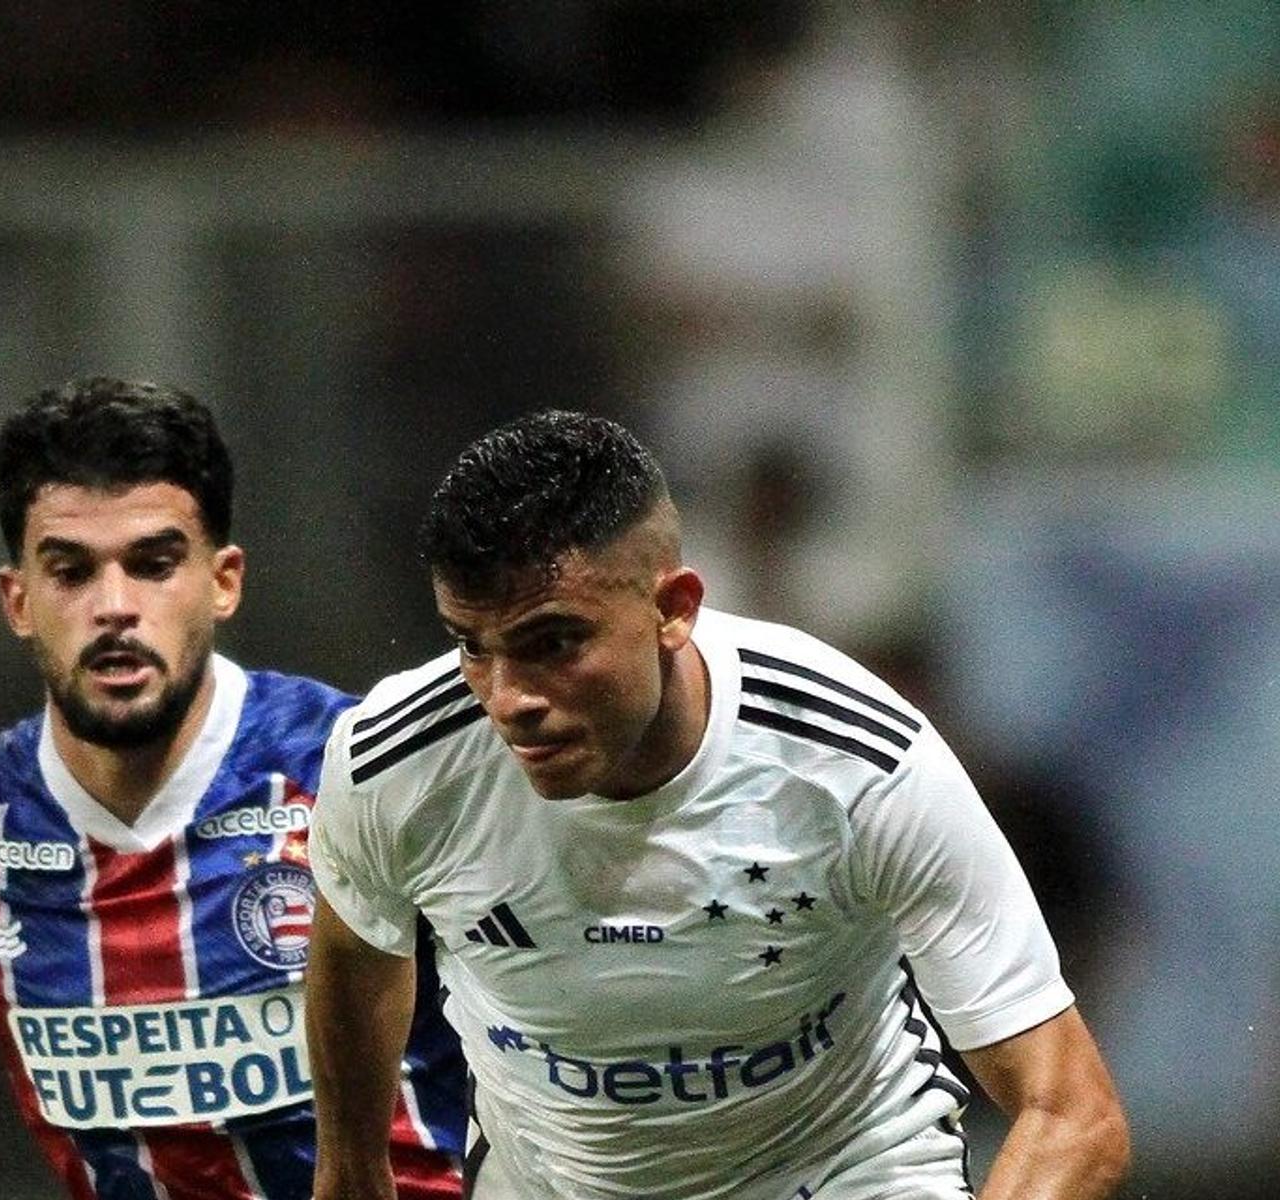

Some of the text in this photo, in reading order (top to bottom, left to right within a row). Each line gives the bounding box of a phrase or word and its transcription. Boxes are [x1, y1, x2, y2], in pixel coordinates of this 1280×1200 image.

[198, 806, 310, 836] acelen
[583, 925, 665, 943] CIMED
[17, 995, 294, 1057] RESPEITA O
[539, 992, 846, 1104] betfair
[32, 1046, 312, 1121] FUTEBOL
